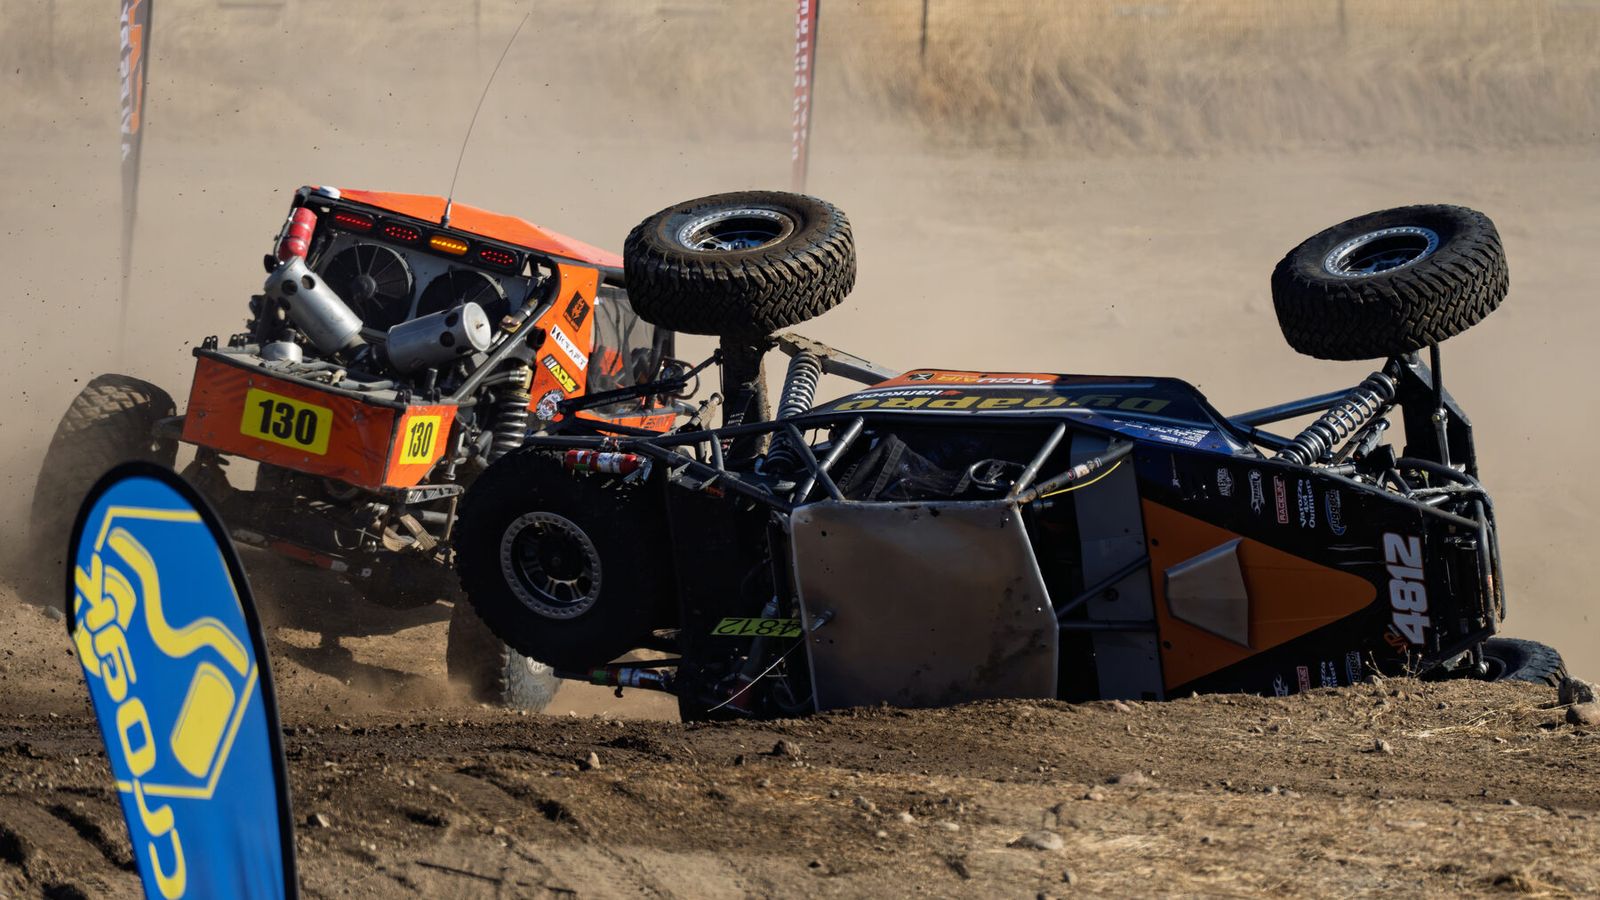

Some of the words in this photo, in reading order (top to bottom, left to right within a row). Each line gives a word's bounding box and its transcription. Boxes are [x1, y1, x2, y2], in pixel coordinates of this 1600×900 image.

[257, 398, 318, 445] 130
[408, 420, 434, 460] 130
[1305, 479, 1315, 529] Outfitters
[1382, 532, 1431, 645] 4812
